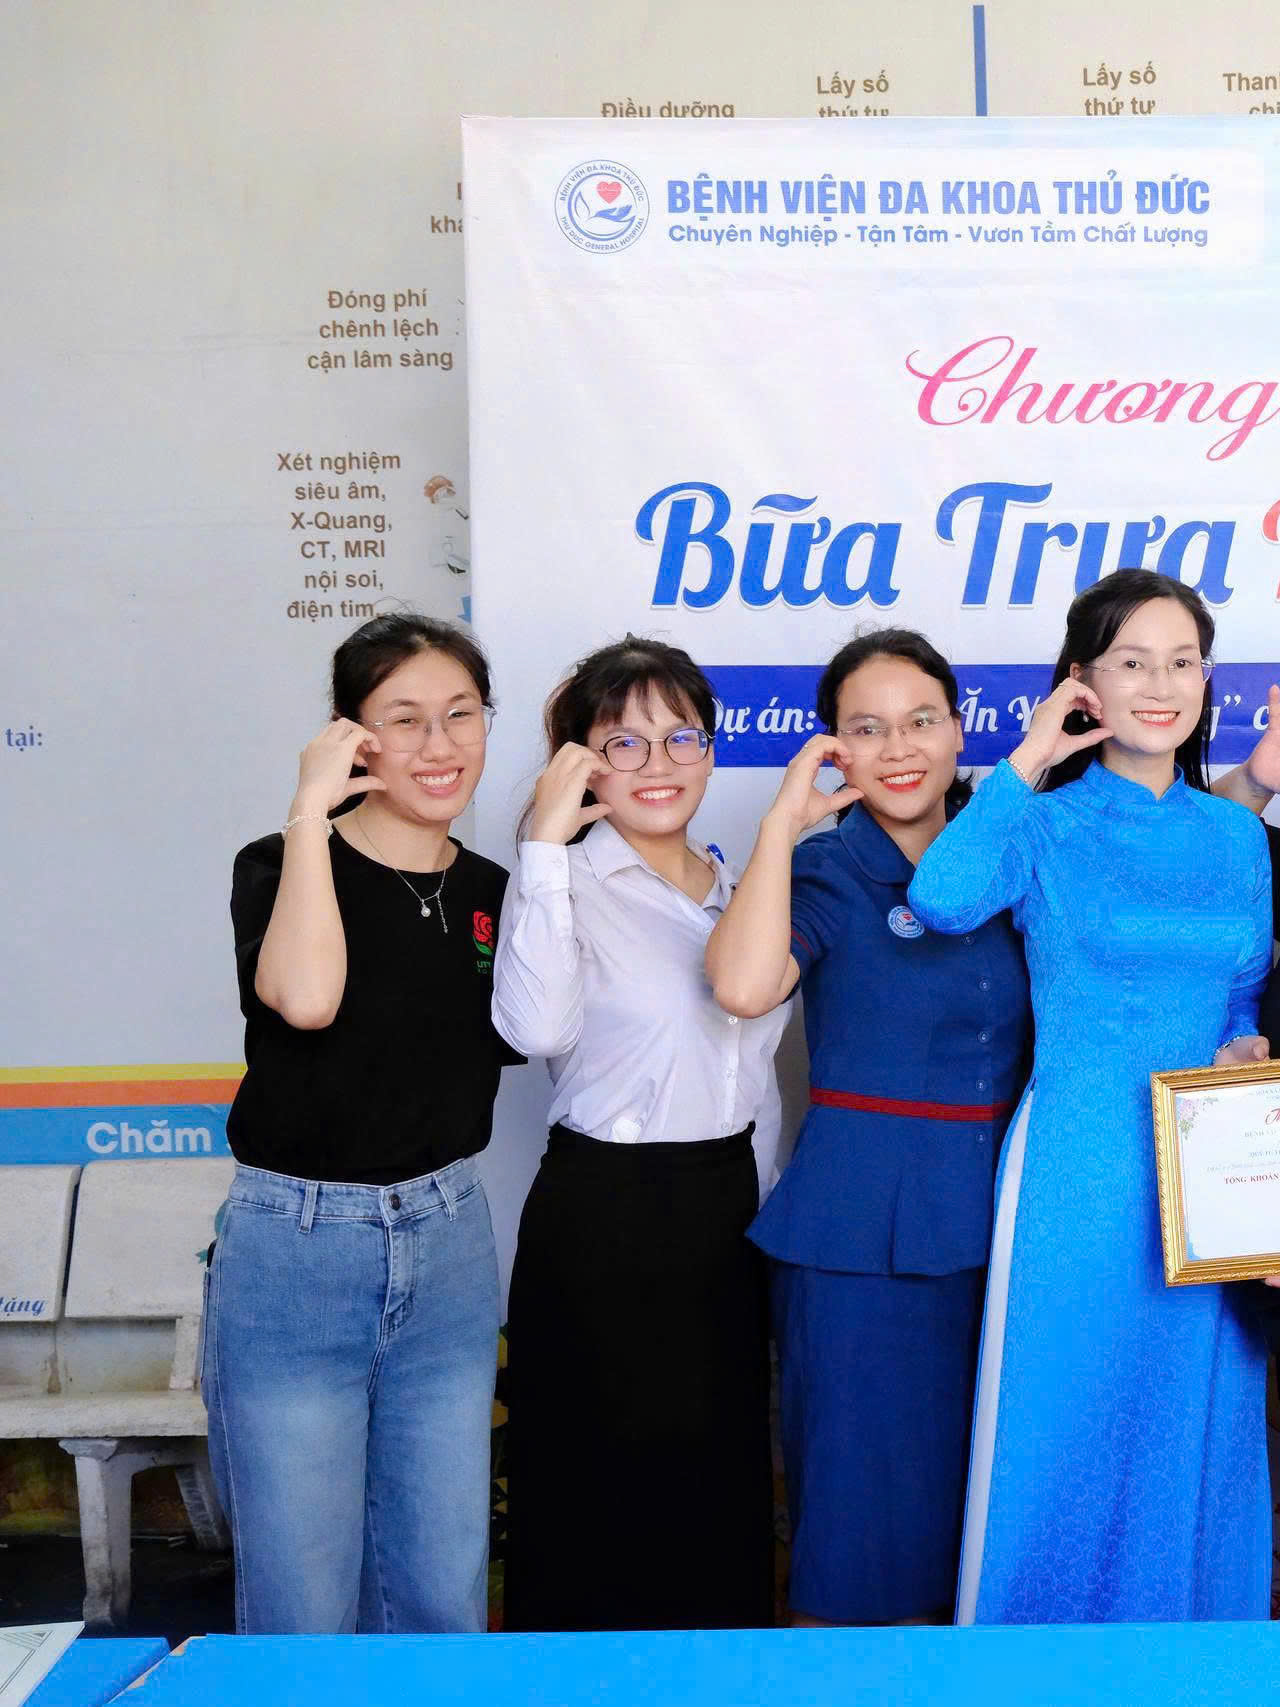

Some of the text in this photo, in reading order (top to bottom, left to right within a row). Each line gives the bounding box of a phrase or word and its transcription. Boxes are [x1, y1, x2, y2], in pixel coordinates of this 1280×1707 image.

[816, 70, 889, 98] Lấy số
[1082, 61, 1157, 90] Lấy số
[1084, 97, 1124, 116] thứ
[667, 169, 1210, 222] BỆNH VIỆN ĐA KHOA THỦ ĐỨC
[668, 224, 752, 246] Chuyên
[760, 224, 838, 248] Nghiệp
[857, 224, 896, 248] Tận
[903, 224, 948, 243] Tâm
[968, 225, 1024, 243] Vươn
[1030, 220, 1076, 243] Tầm
[1083, 221, 1136, 243] Chất
[1144, 225, 1208, 248] Lượng
[327, 288, 427, 313] Đóng phí
[319, 318, 439, 341] chênh lệch
[307, 349, 453, 374] cận lâm sàng
[277, 452, 401, 475] Xét nghiệm
[295, 481, 386, 502] siêu âm,
[291, 511, 392, 533] X-Quang,
[300, 540, 385, 561] CT, MRI
[635, 481, 903, 609] Bữa
[936, 482, 1235, 607] Trưa
[304, 569, 384, 593] nội soi,
[287, 600, 333, 623] điện
[757, 696, 816, 734] án:
[957, 687, 998, 733] Ăn
[5, 725, 43, 752] tại:
[86, 1119, 212, 1154] Chăm
